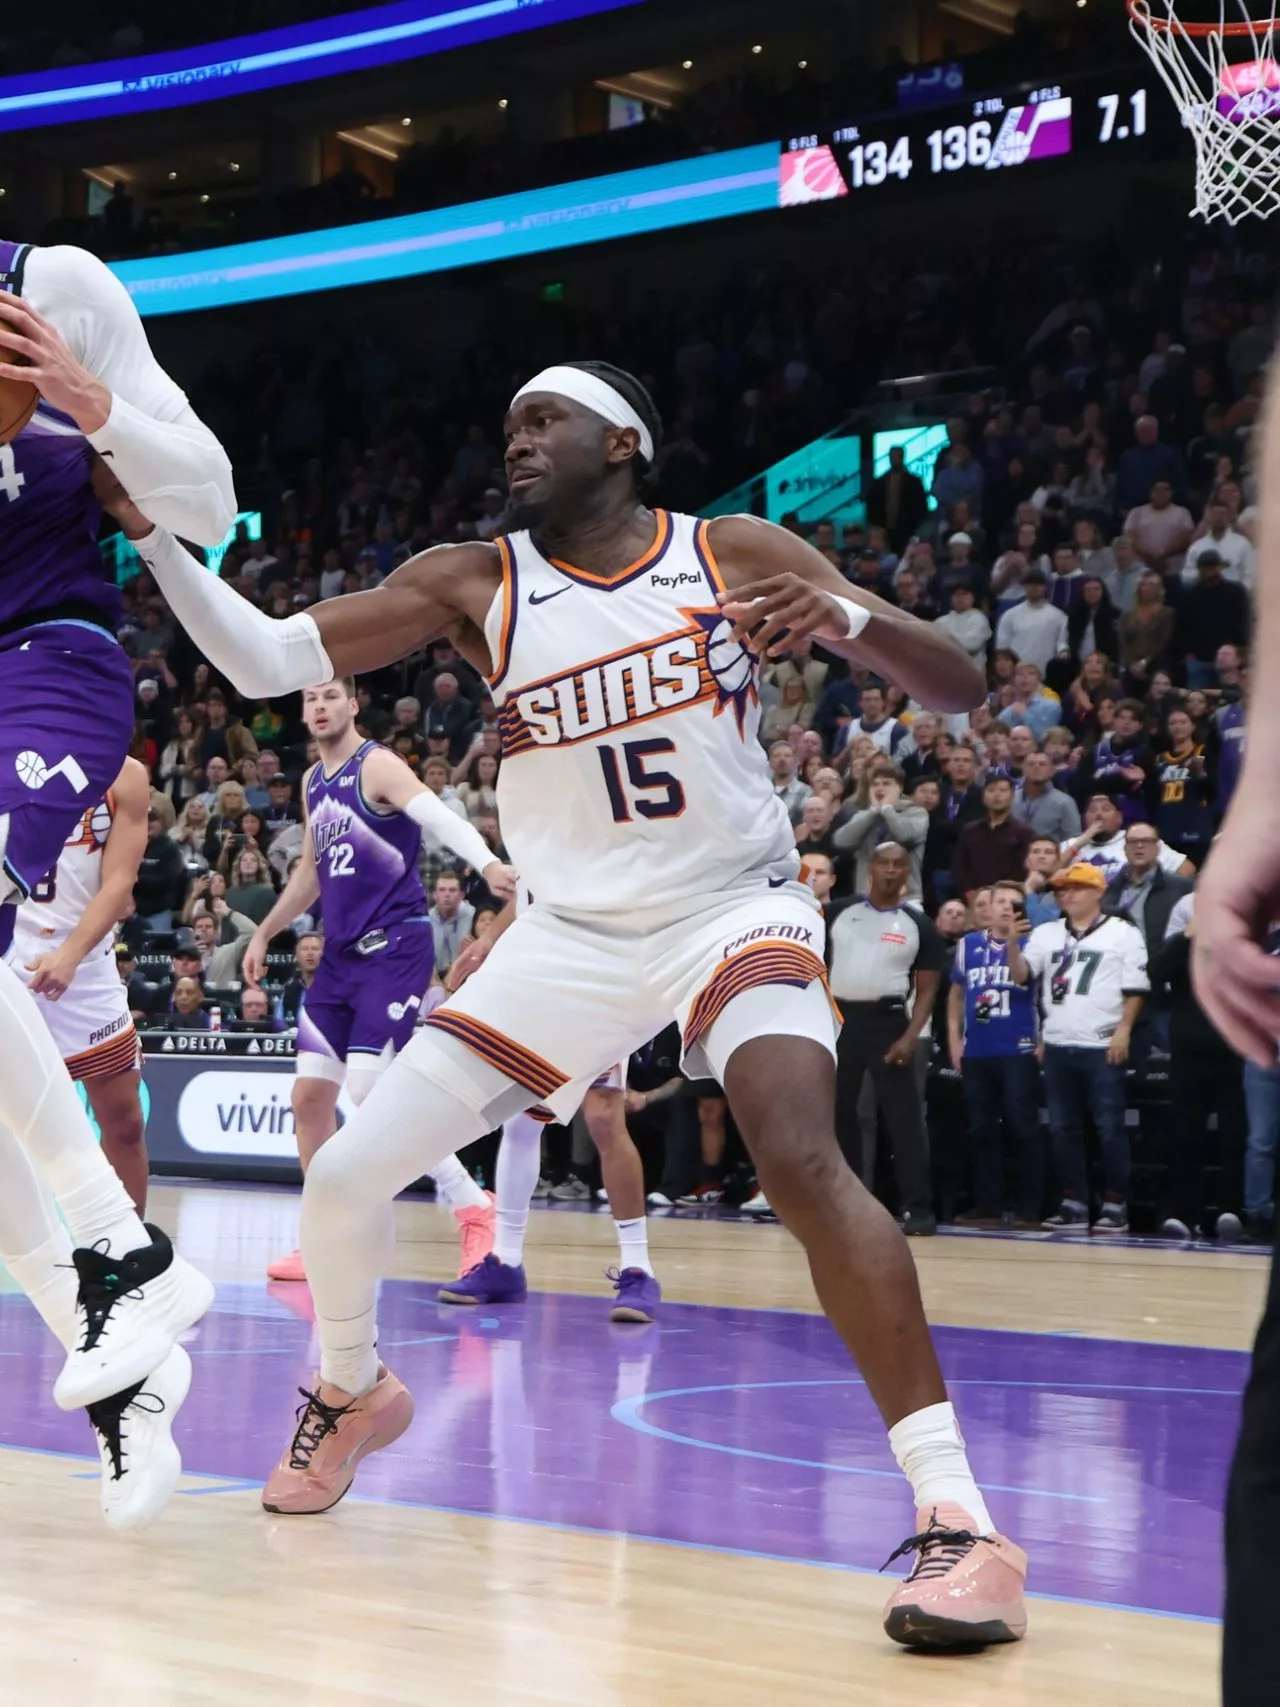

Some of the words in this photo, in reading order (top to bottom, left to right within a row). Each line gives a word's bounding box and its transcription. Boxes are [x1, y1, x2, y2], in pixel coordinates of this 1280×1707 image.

[1097, 88, 1147, 143] 7.1
[848, 135, 913, 188] 134
[926, 120, 993, 174] 136
[651, 571, 702, 588] PayPal
[517, 635, 701, 745] SUNS
[596, 737, 687, 824] 15
[311, 815, 354, 864] UTAH
[328, 842, 356, 878] 22
[140, 955, 173, 965] DELTA
[724, 925, 813, 960] PHOENIX
[967, 965, 1028, 991] PHIL
[1051, 949, 1106, 998] 27
[177, 1036, 227, 1051] DELTA
[264, 1038, 294, 1052] DEL
[217, 1093, 297, 1135] vivin
